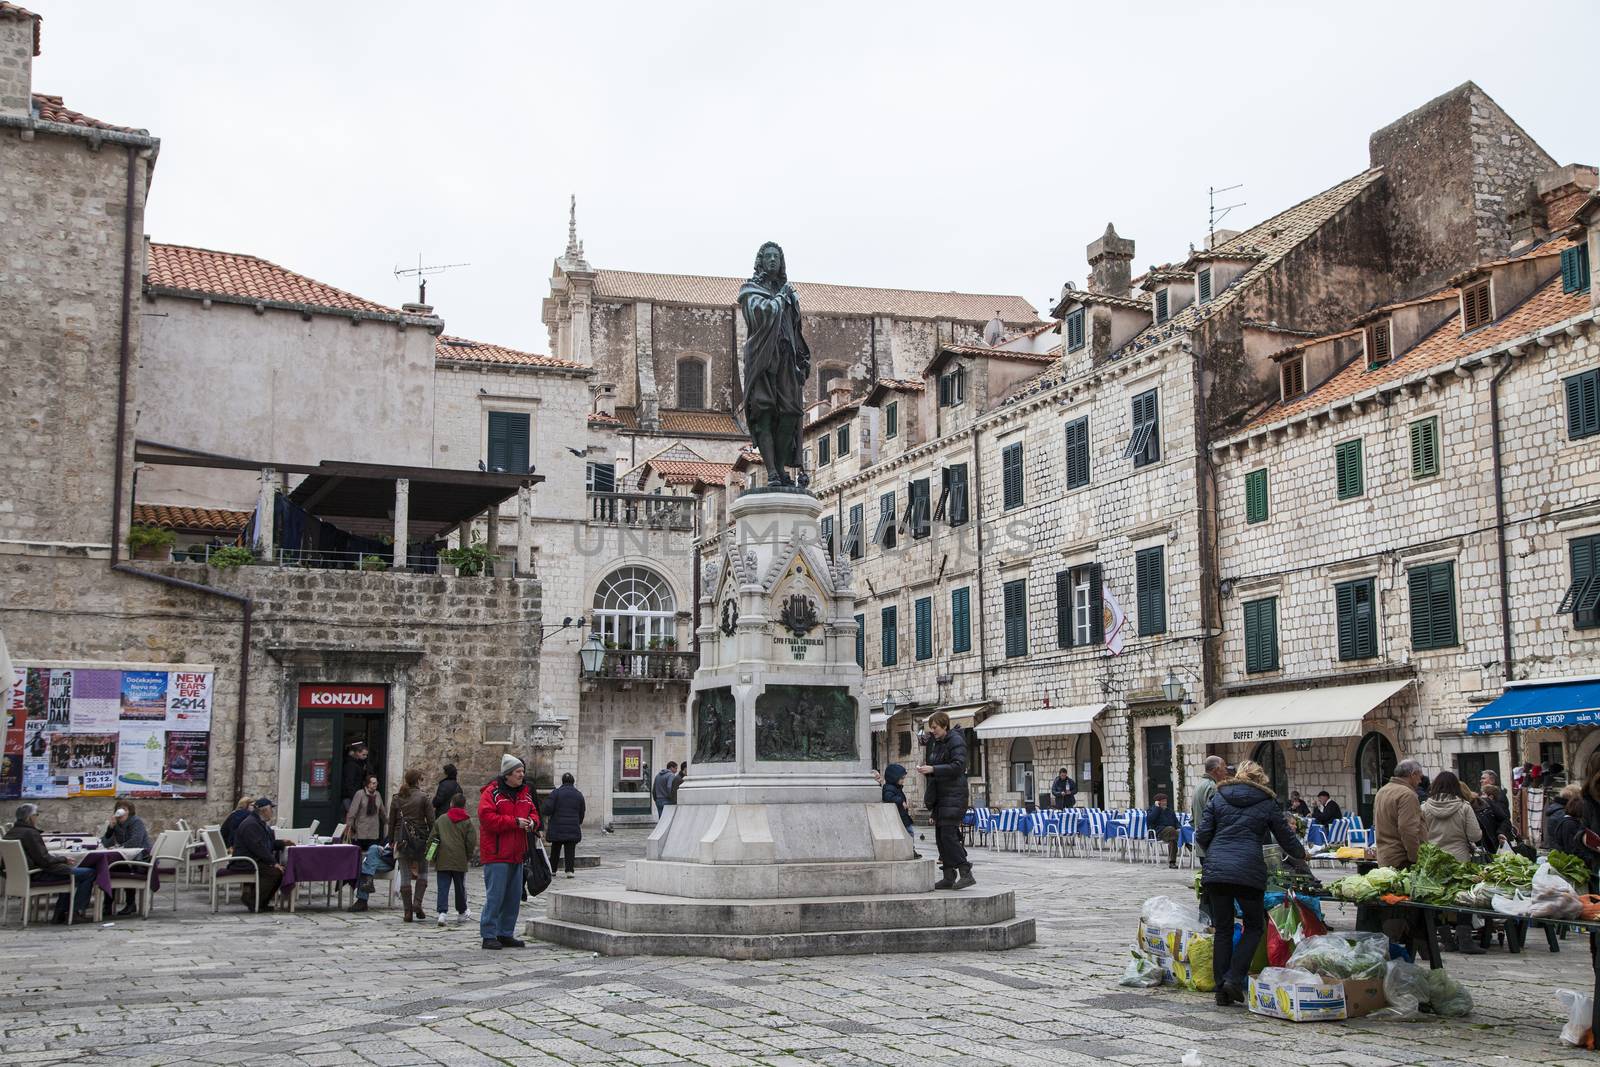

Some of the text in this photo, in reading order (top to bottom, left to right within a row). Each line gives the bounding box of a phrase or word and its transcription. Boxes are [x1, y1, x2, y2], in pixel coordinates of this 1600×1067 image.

[176, 673, 206, 683] NEW
[175, 682, 206, 690] YEAR'S
[180, 689, 200, 698] EVE
[310, 692, 373, 705] KONZUM
[49, 697, 71, 709] NOVI
[170, 698, 206, 710] 2014
[48, 709, 70, 722] DAN
[1510, 714, 1565, 727] LEATHER SHOP
